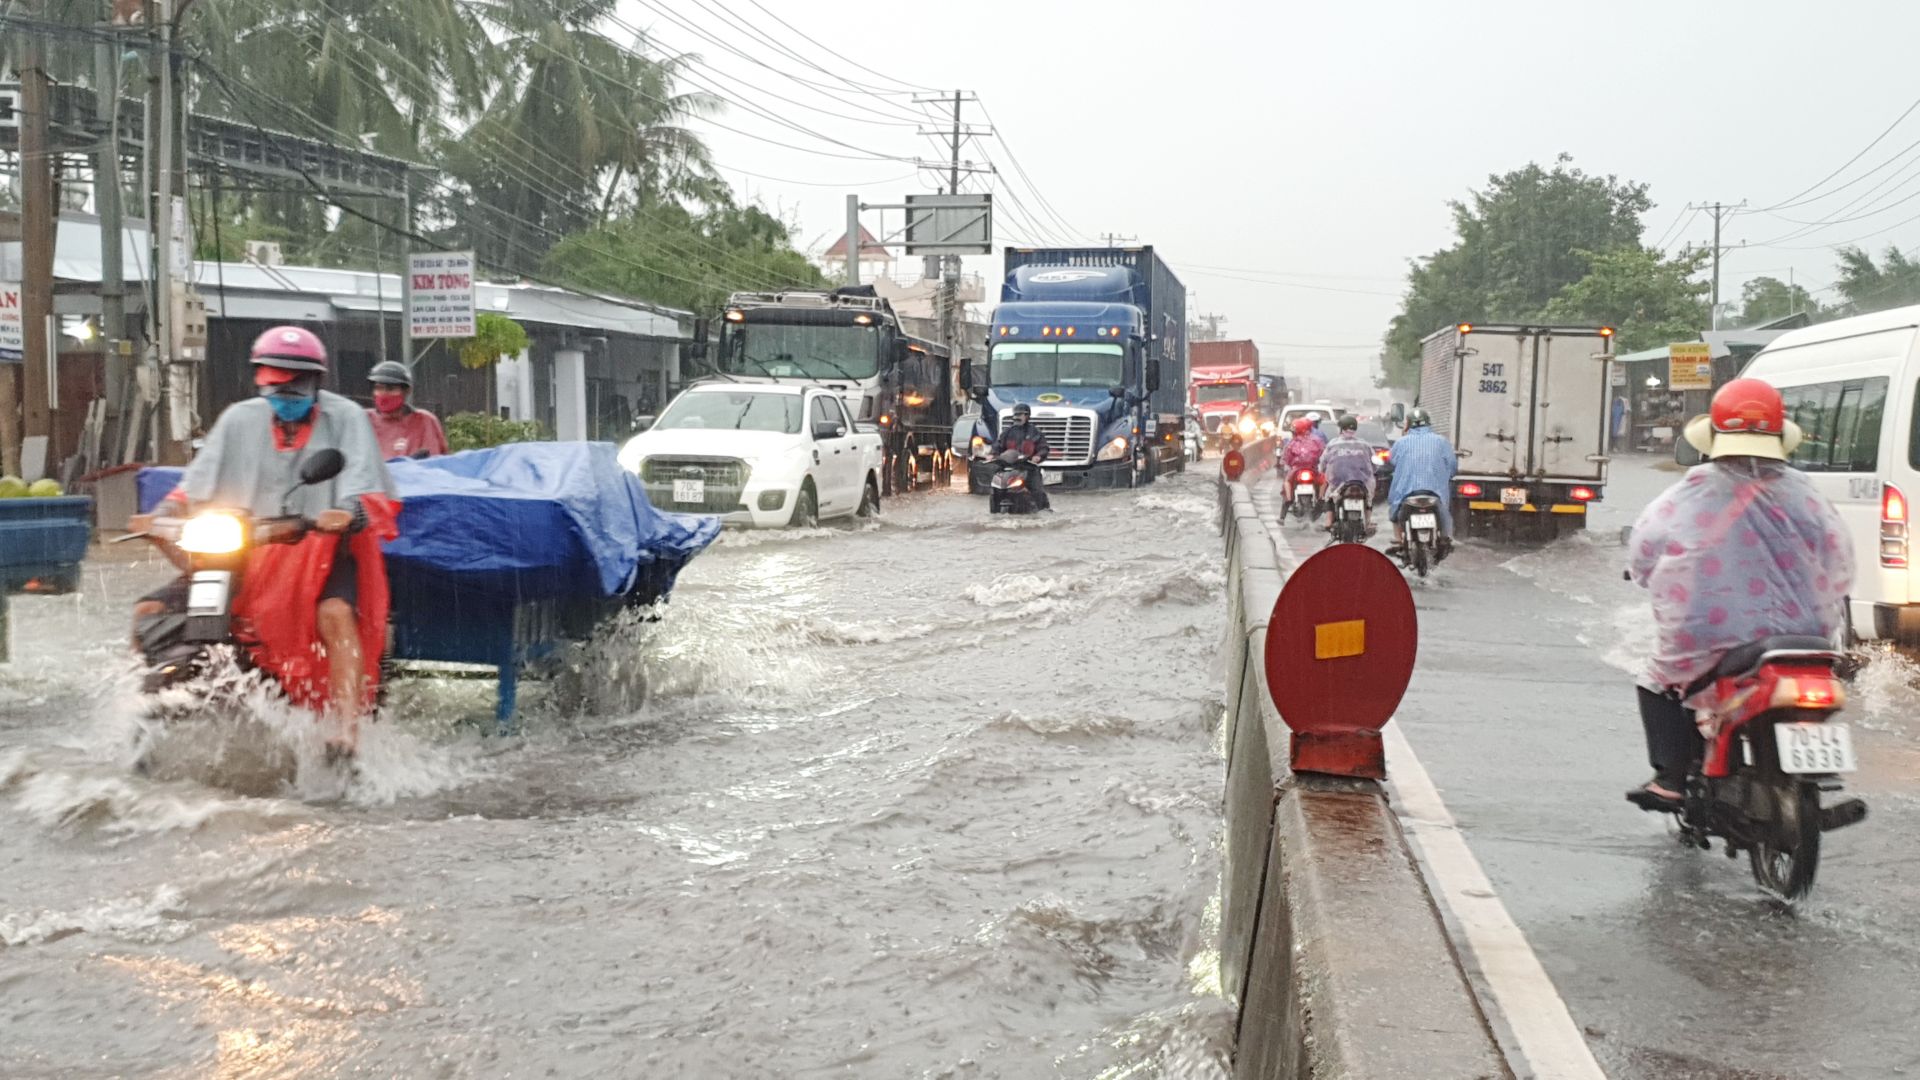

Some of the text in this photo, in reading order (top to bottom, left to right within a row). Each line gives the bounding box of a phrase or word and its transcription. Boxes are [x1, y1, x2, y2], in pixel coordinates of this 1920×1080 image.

[412, 274, 435, 290] KIM
[1482, 363, 1504, 376] 54T
[1479, 380, 1507, 393] 3862
